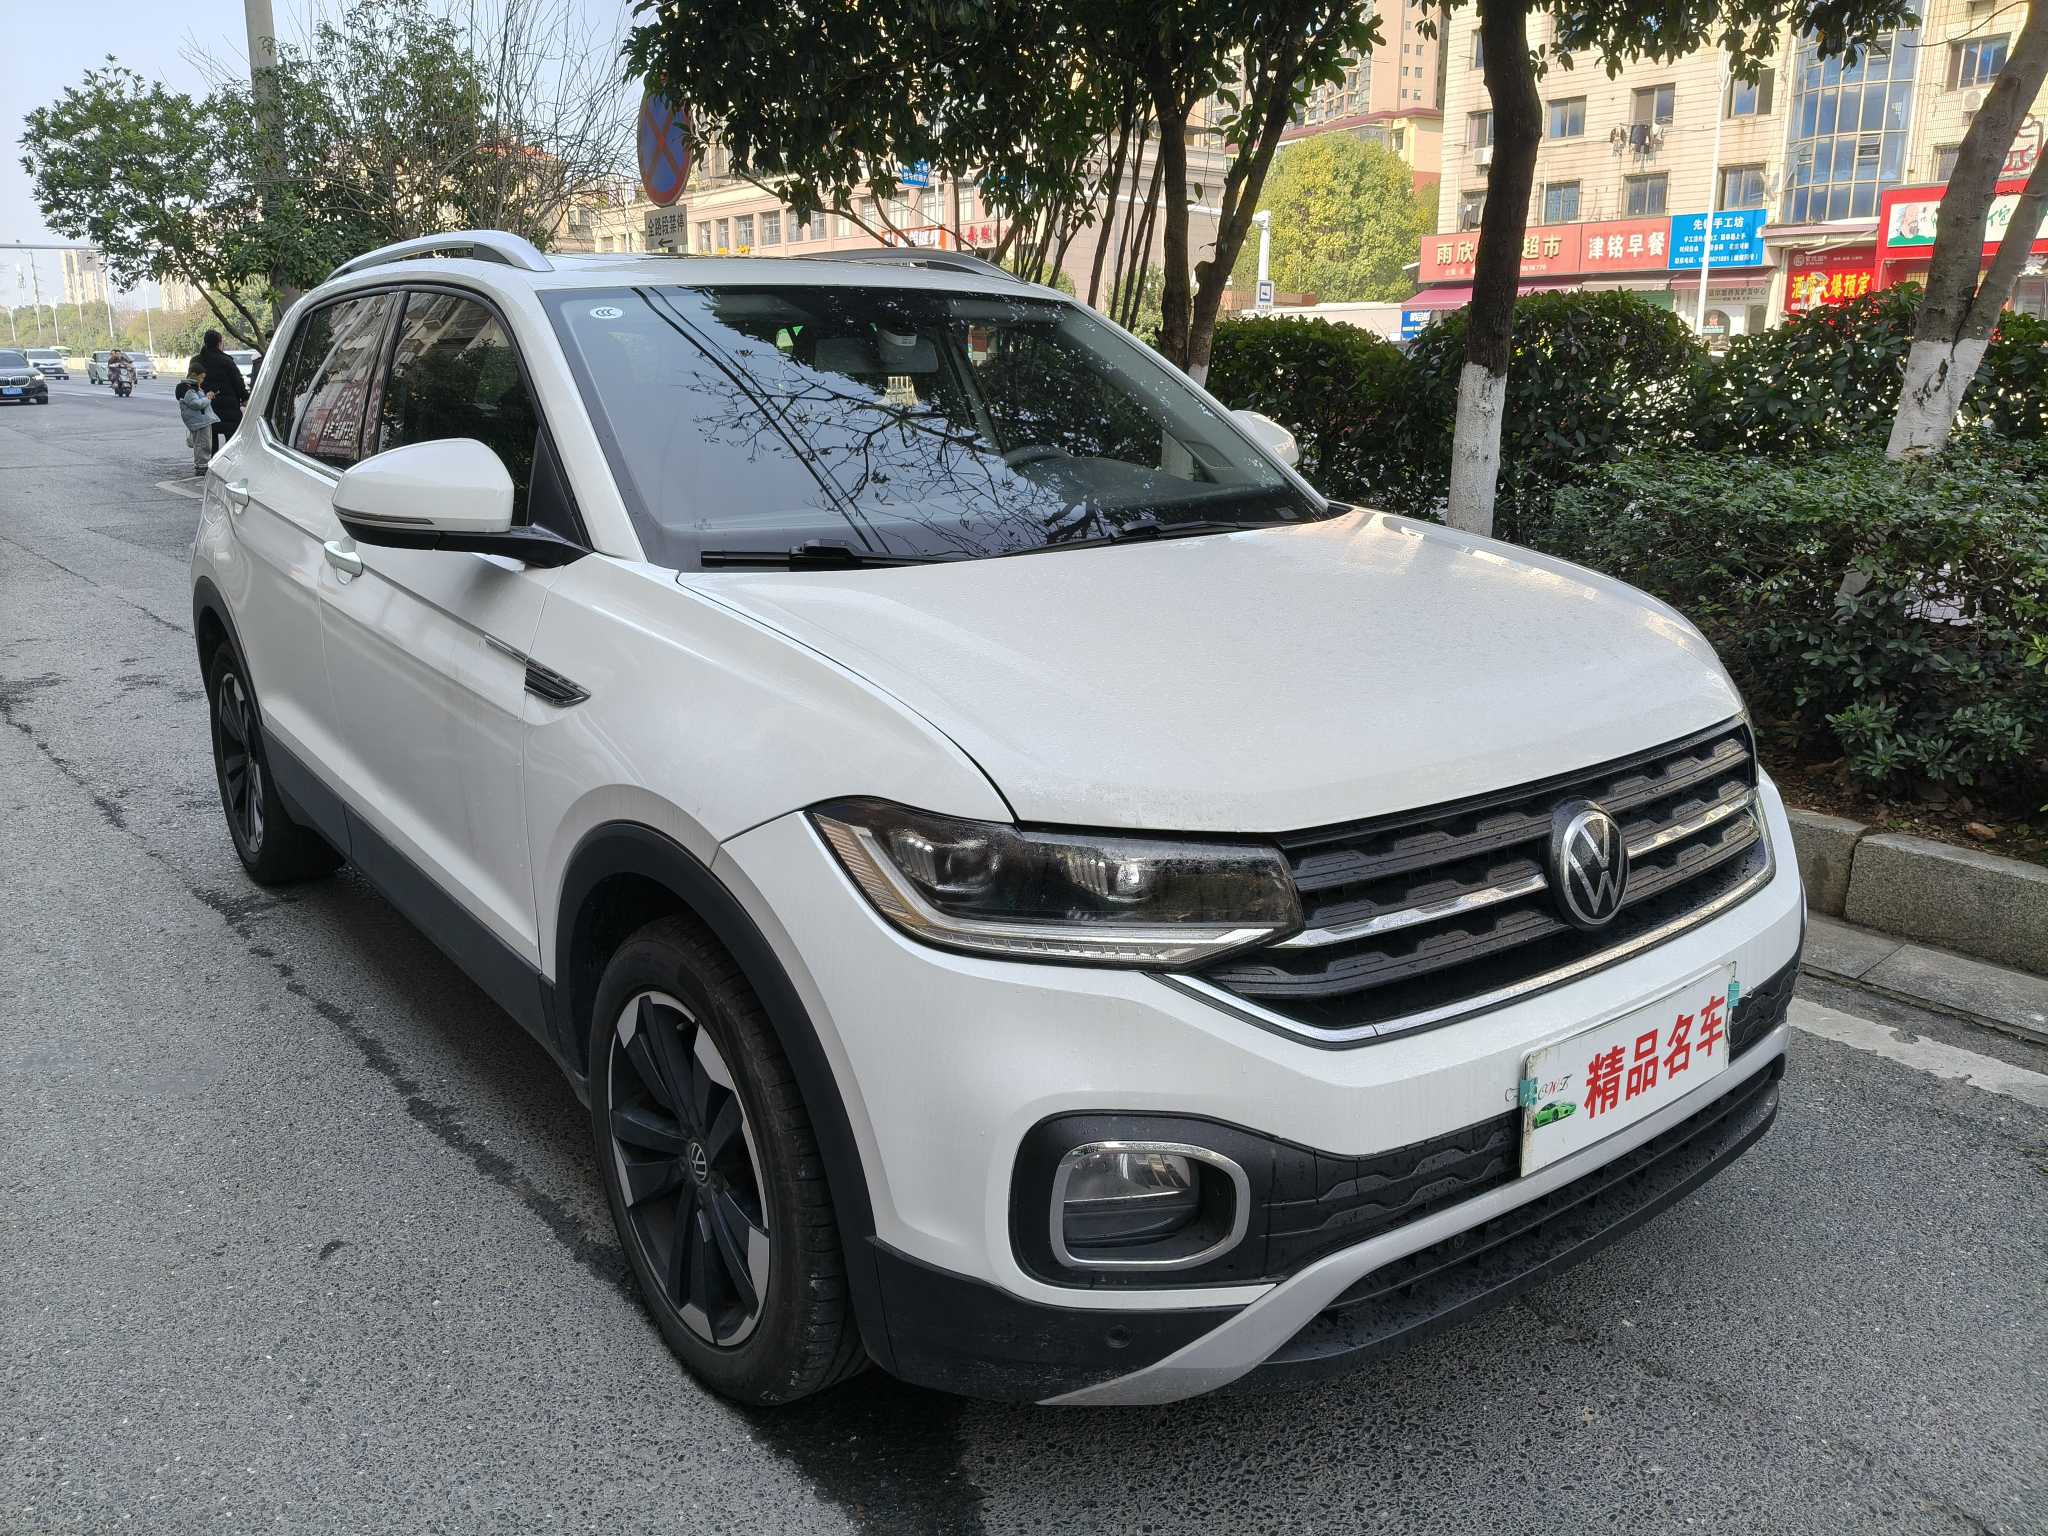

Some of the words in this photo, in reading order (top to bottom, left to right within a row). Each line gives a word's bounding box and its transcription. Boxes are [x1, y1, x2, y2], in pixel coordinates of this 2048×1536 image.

[647, 212, 685, 238] 全路段禁停
[1436, 234, 1562, 266] 雨欣超市
[1588, 231, 1666, 260] 津铭早餐
[1584, 995, 1726, 1120] 精品名车
